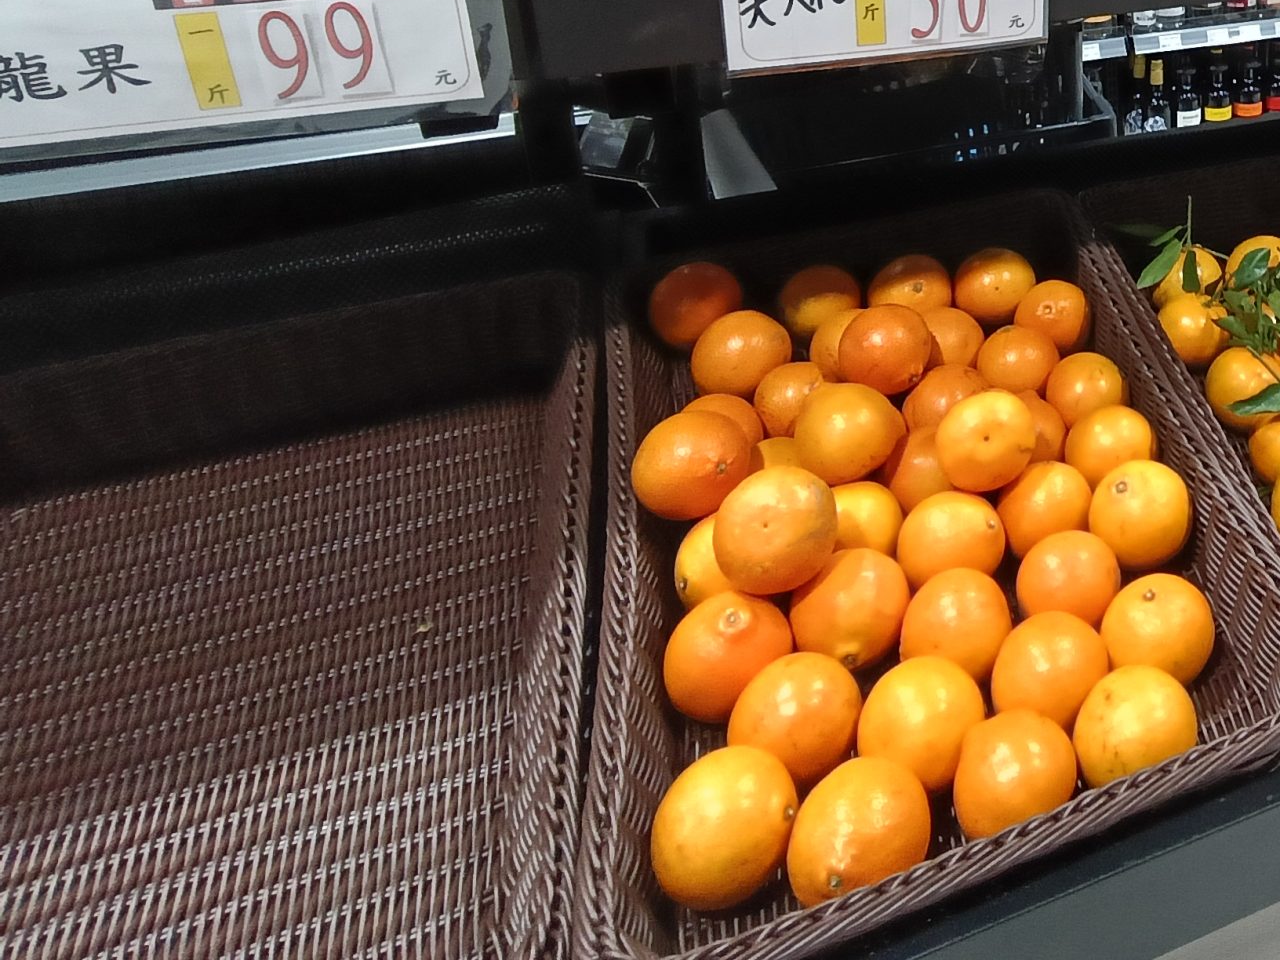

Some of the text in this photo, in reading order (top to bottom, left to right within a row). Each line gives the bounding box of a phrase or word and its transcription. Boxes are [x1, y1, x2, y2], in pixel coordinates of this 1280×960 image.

[1008, 15, 1025, 29] 元
[257, 1, 374, 100] 99
[0, 43, 152, 102] 龍果
[434, 69, 457, 87] 元
